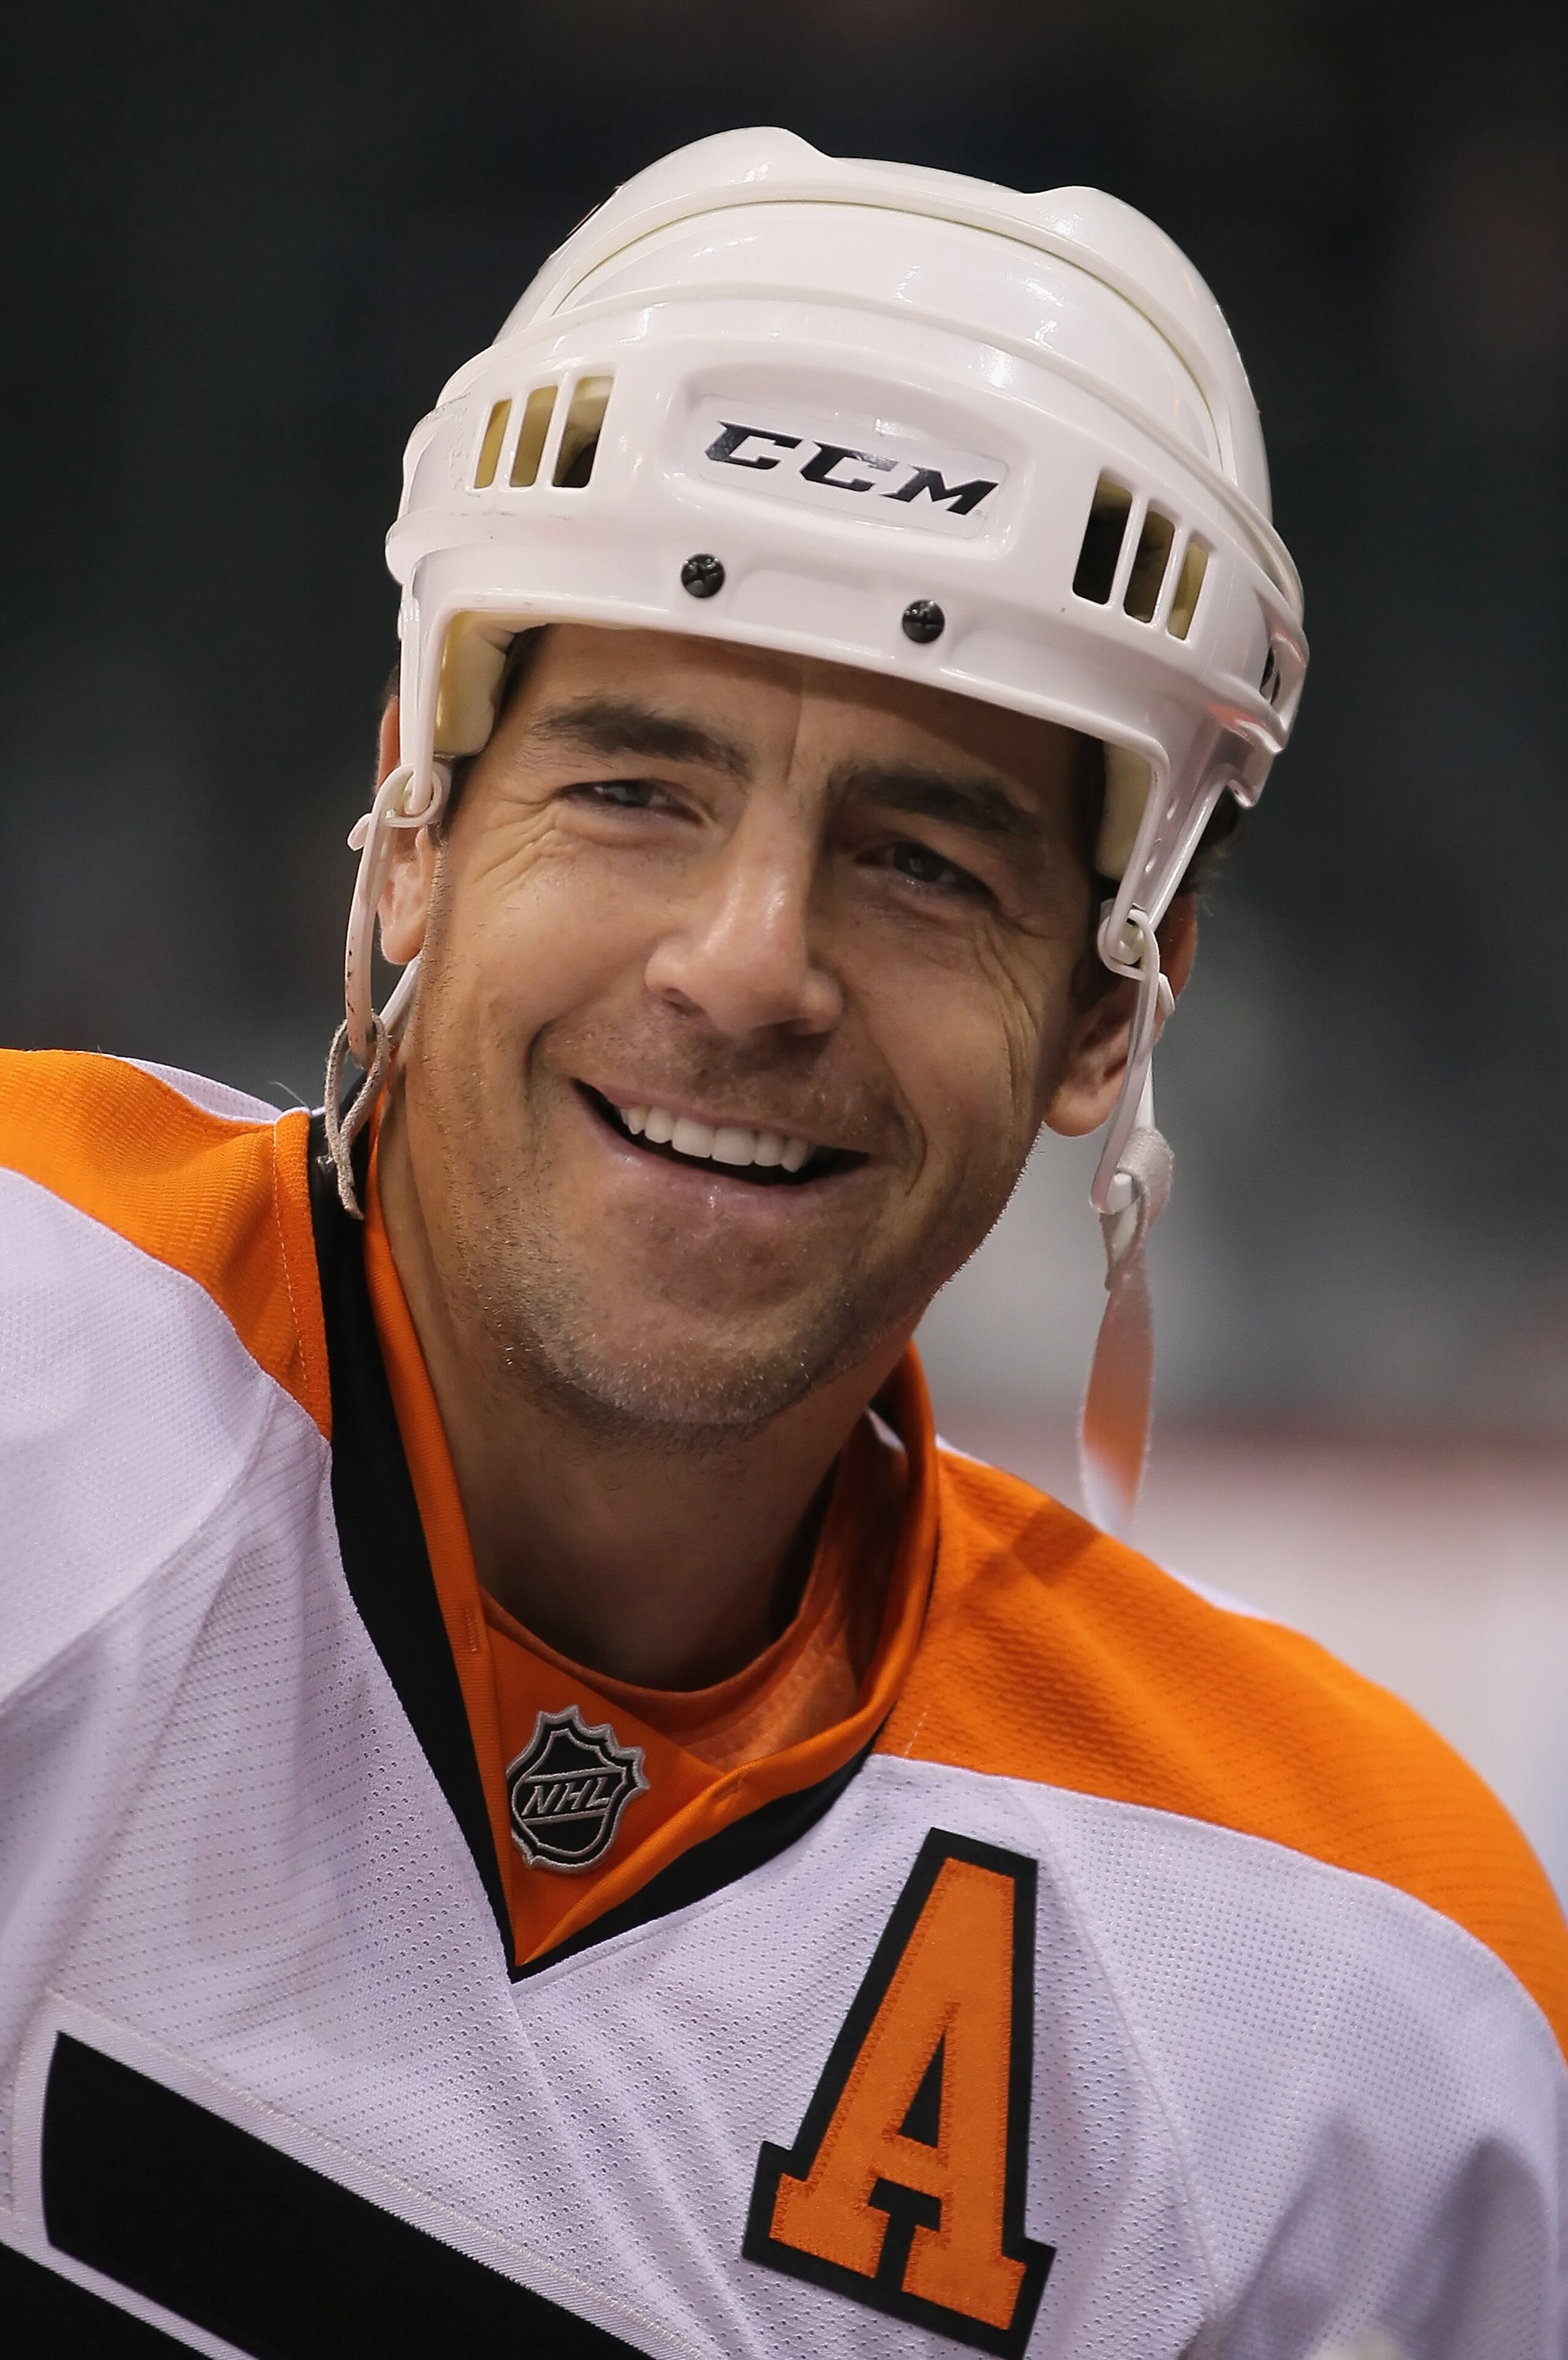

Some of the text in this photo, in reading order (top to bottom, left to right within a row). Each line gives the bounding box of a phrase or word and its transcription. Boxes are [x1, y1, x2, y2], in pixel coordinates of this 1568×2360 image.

[705, 420, 999, 515] CCM
[521, 1777, 611, 1816] NHL
[744, 1828, 1056, 2359] A
